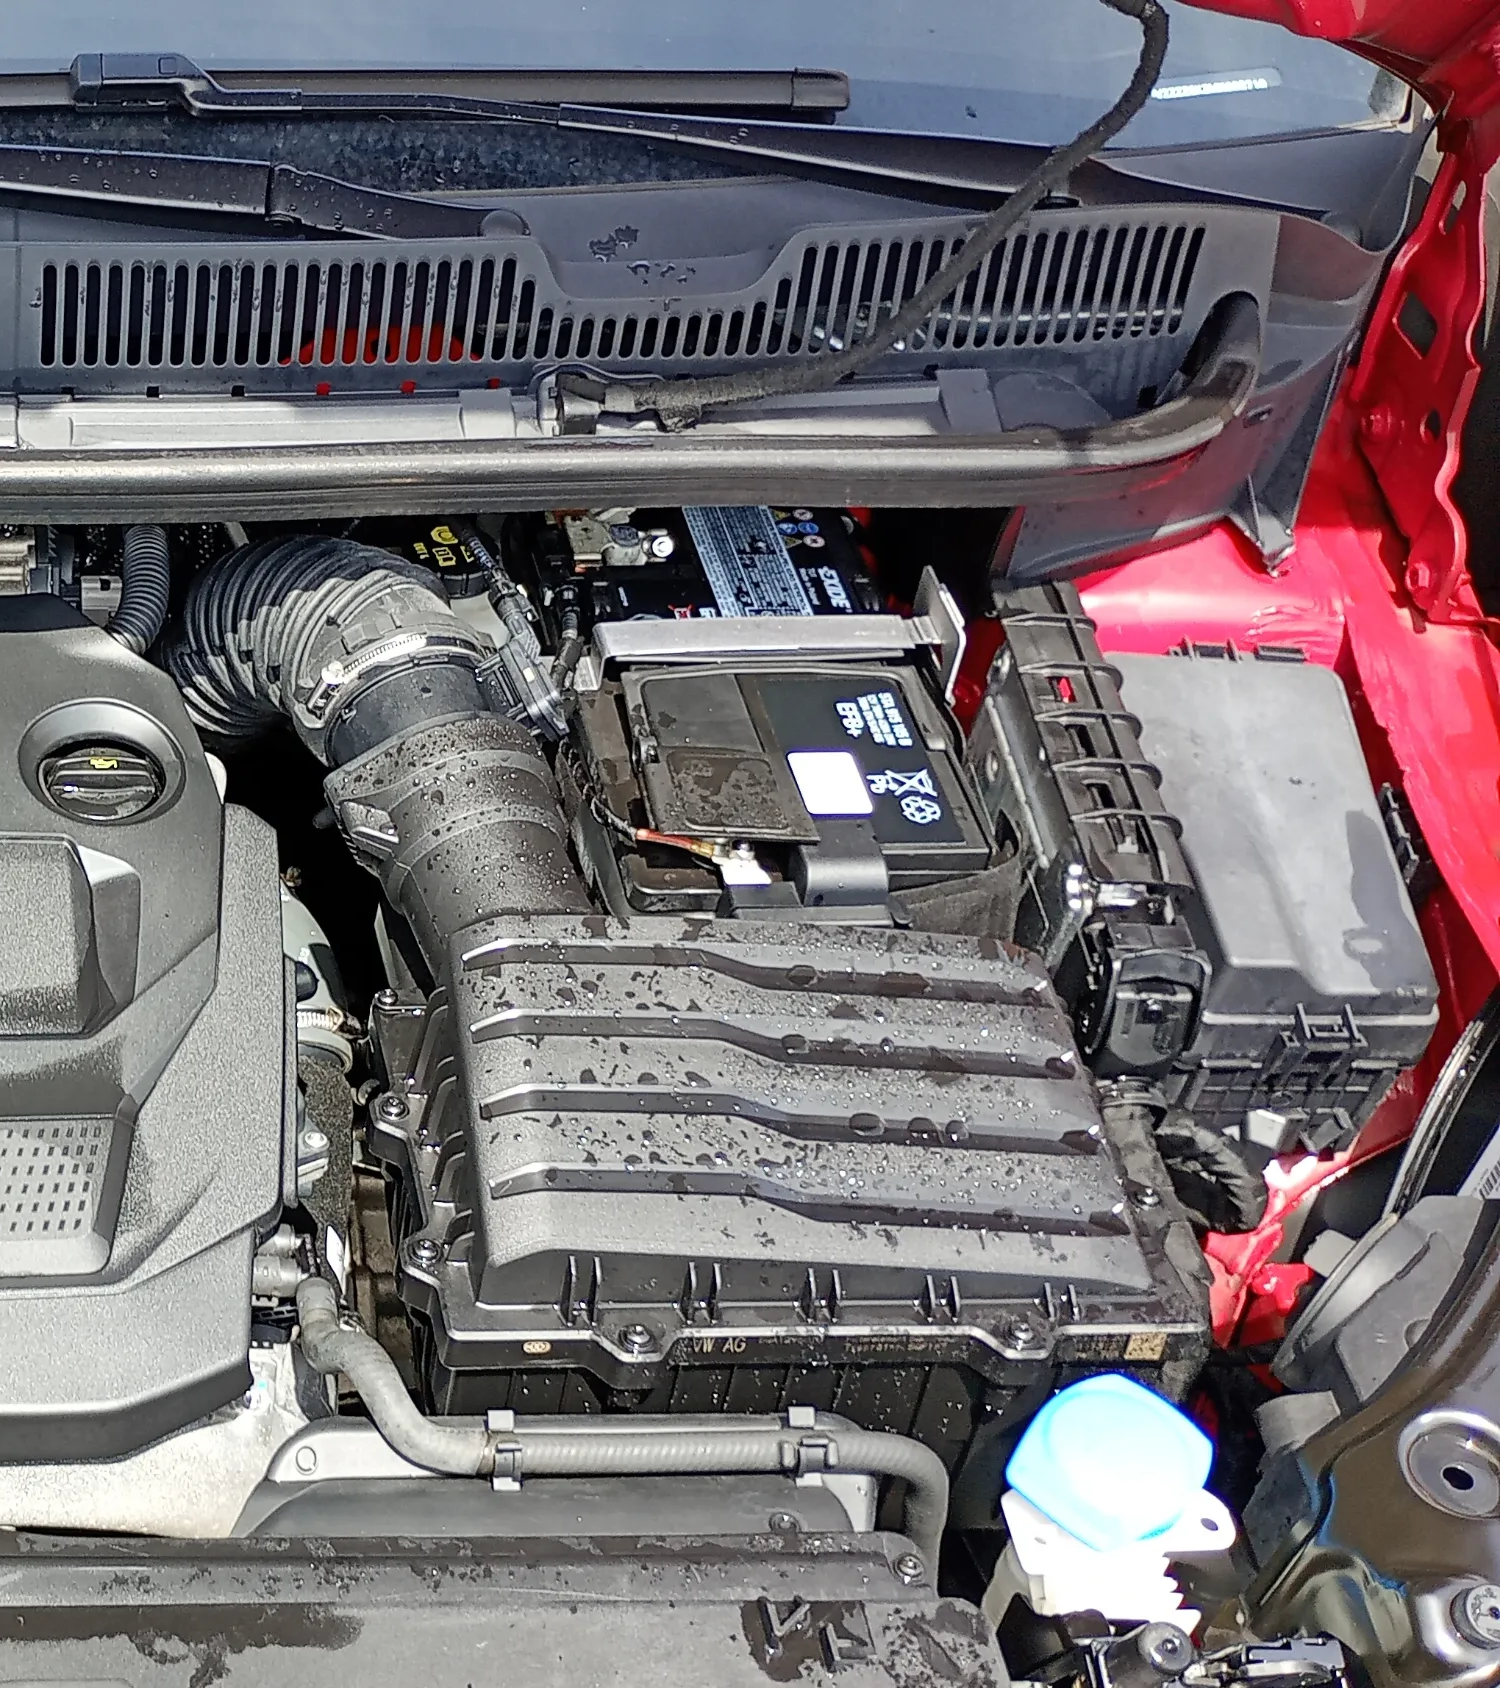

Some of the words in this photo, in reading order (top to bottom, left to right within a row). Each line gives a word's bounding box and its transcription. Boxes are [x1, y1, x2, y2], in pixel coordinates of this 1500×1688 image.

[817, 566, 852, 609] EXIDE
[835, 702, 864, 738] EFB+
[722, 1336, 746, 1353] AG
